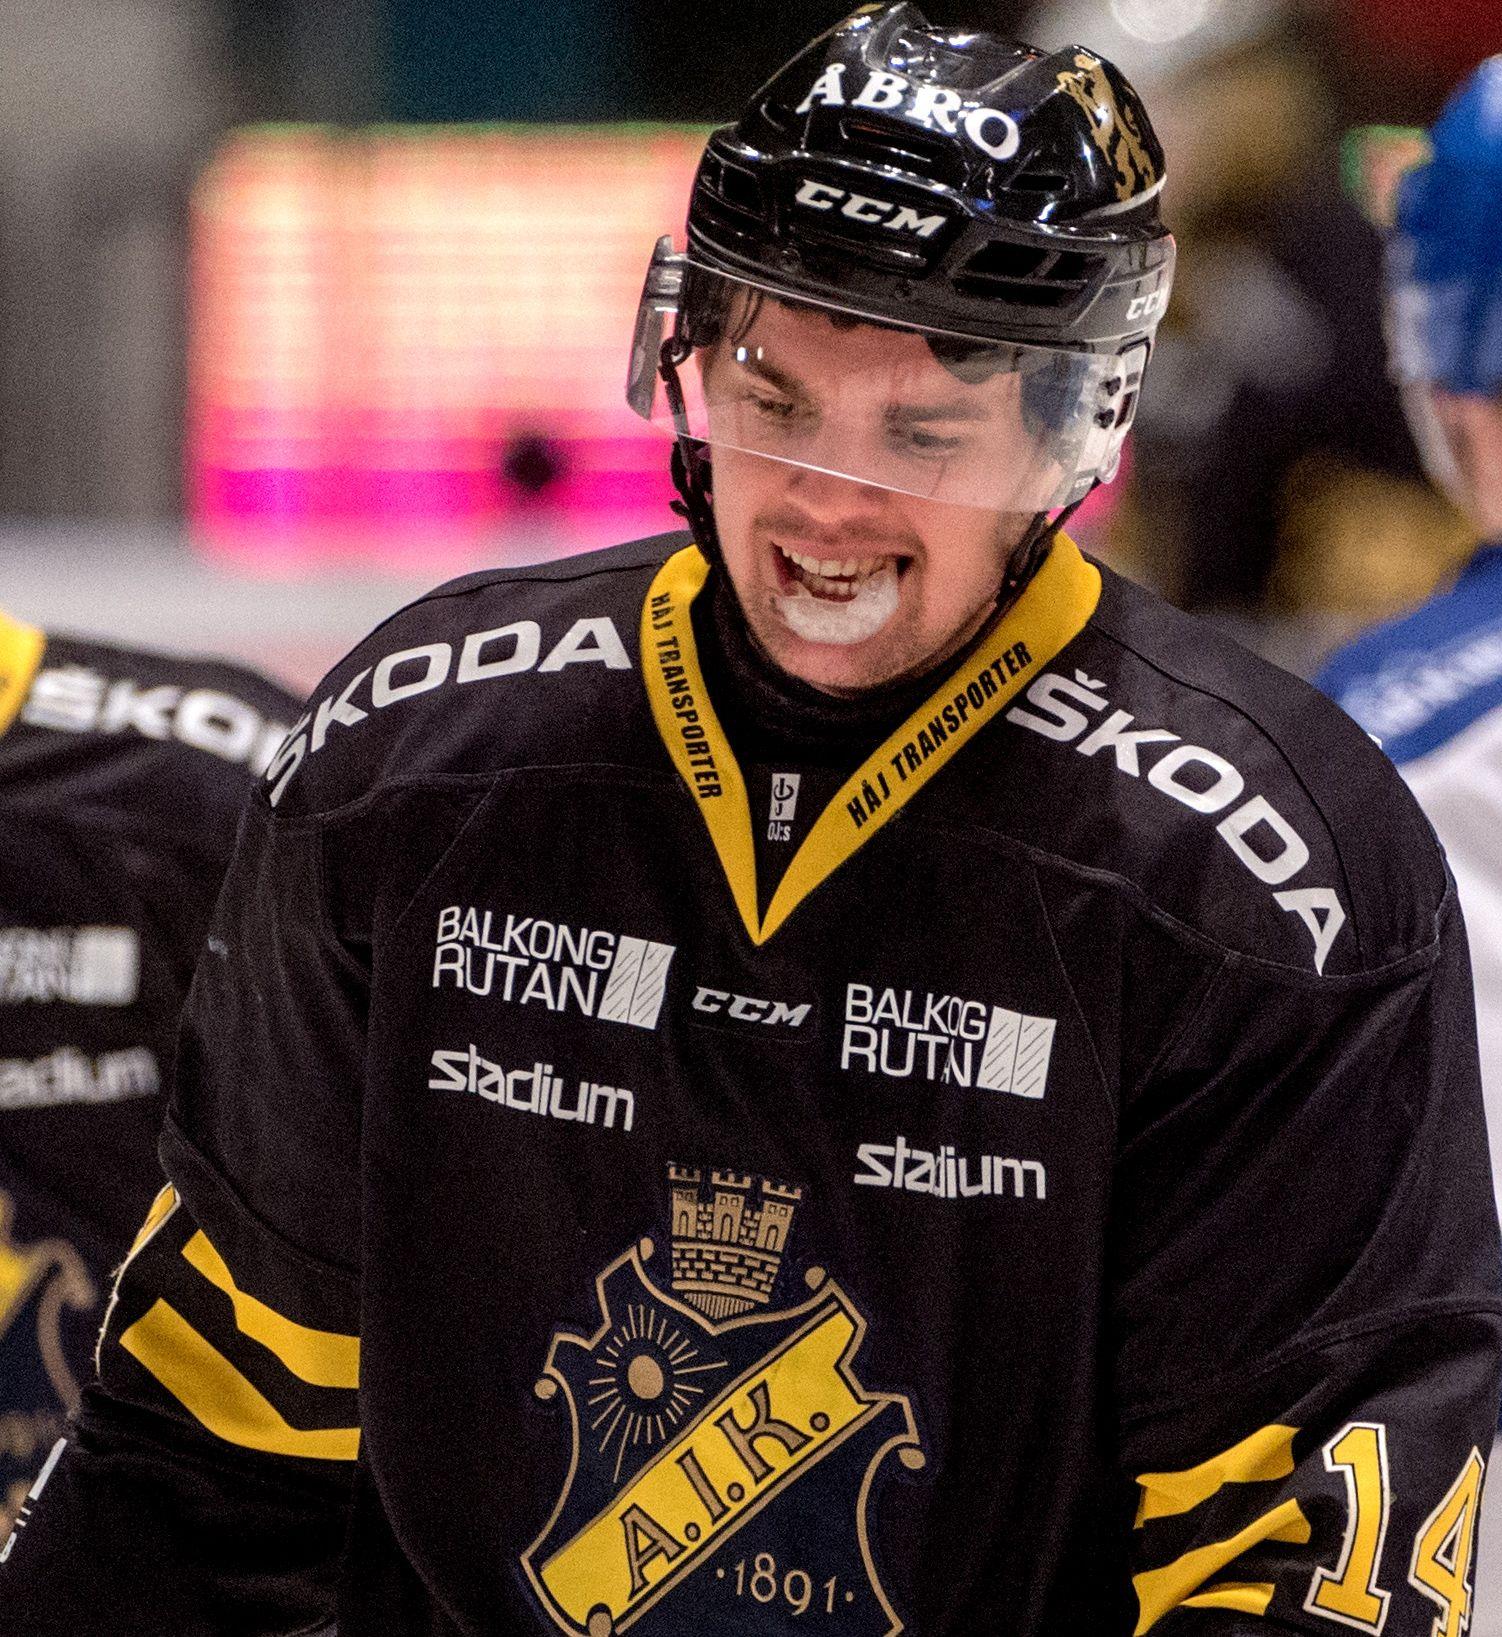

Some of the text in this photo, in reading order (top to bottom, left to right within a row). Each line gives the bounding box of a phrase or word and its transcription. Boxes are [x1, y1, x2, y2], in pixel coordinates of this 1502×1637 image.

[796, 62, 1021, 160] ÅBRO
[794, 178, 946, 238] CCM
[656, 635, 724, 800] TRANSPORTER
[846, 640, 1033, 829] HÅJ TRANSPORTER
[1005, 668, 1348, 978] ŠKODA
[432, 942, 598, 1017] RUTAN
[437, 906, 613, 970] BALKONG
[691, 986, 811, 1026] CCM
[428, 1044, 634, 1132] stadium
[618, 1378, 831, 1602] A.I.K.
[1303, 1421, 1485, 1637] 14
